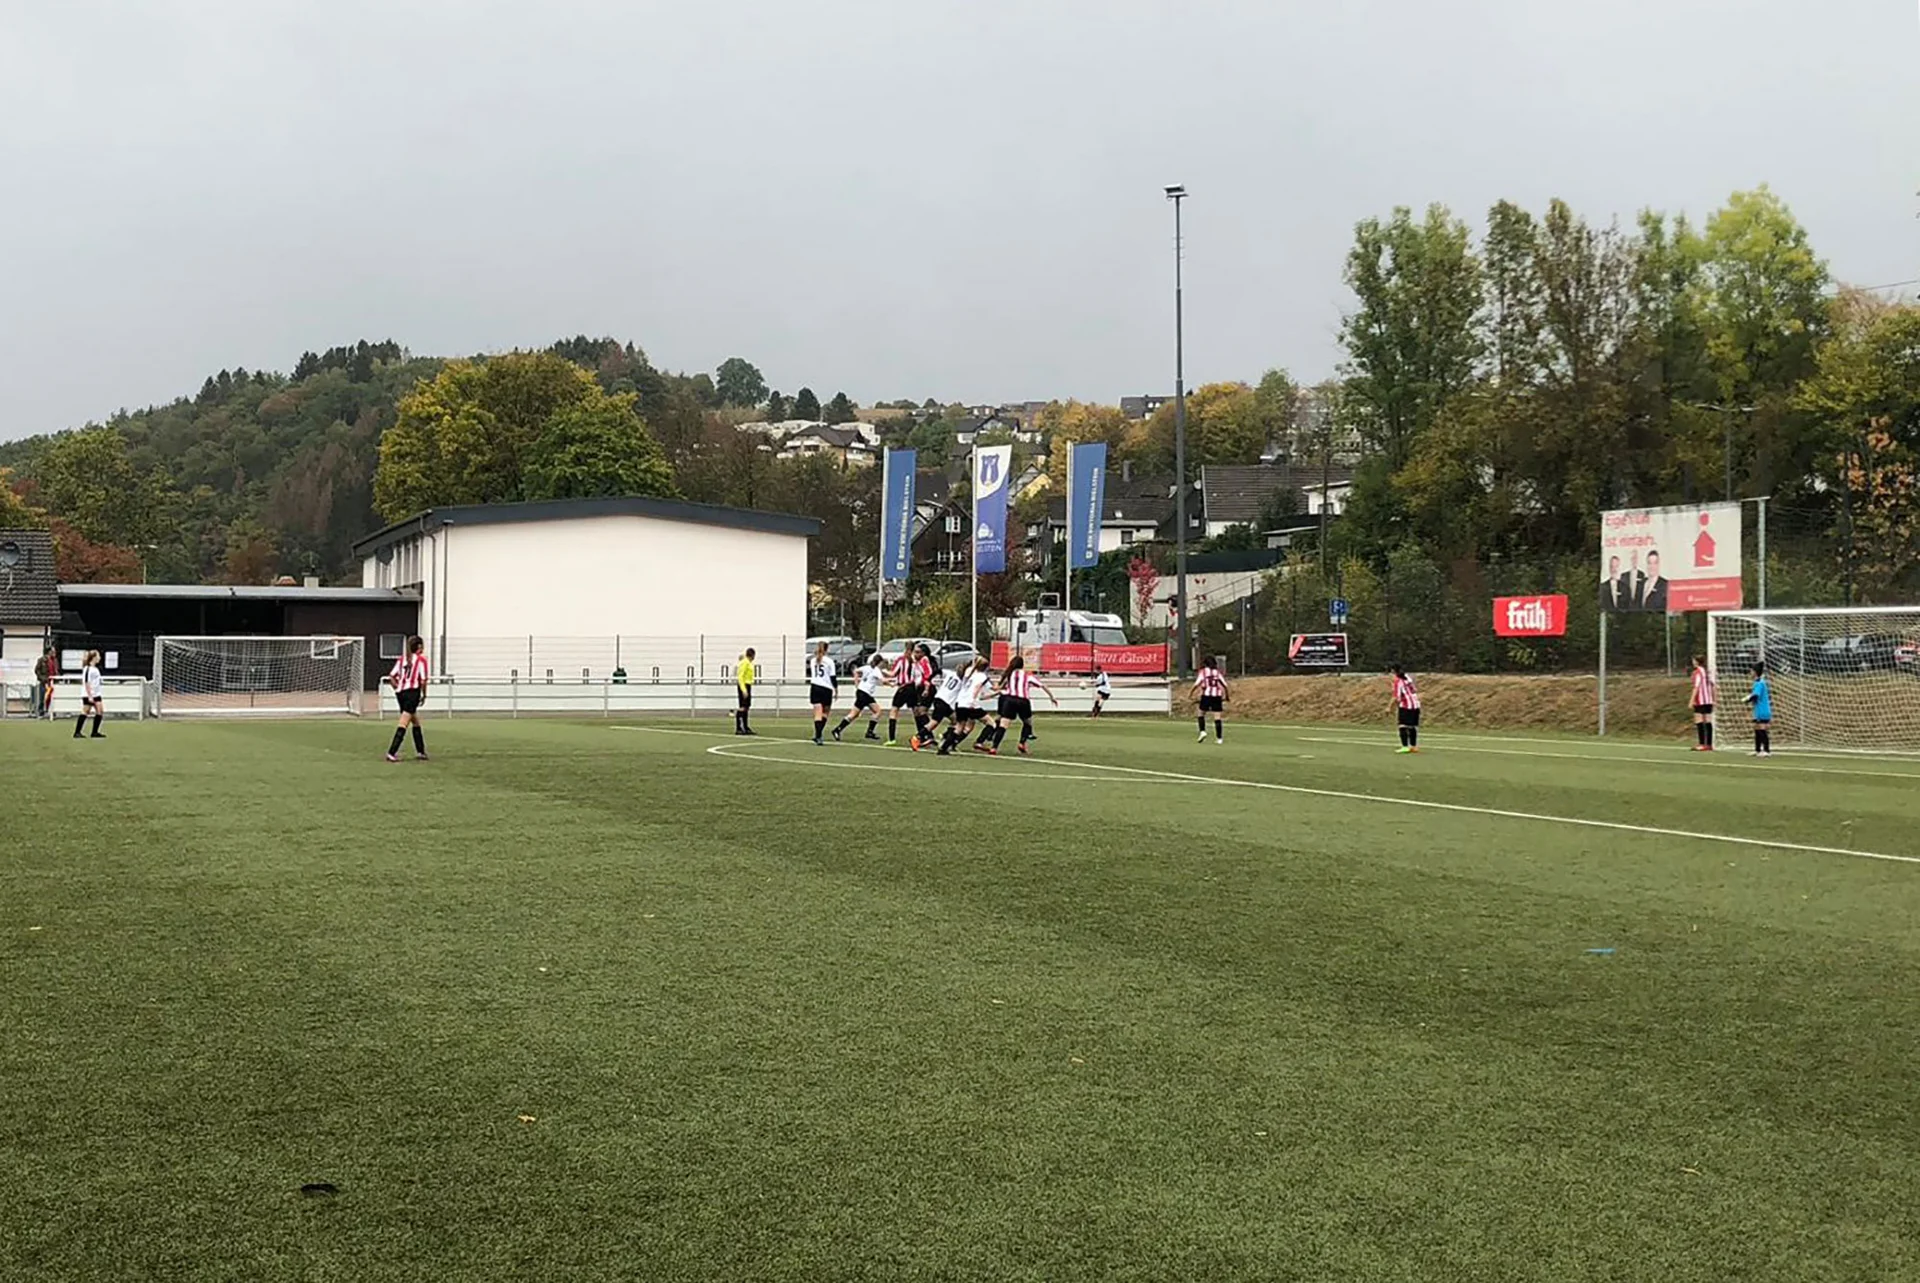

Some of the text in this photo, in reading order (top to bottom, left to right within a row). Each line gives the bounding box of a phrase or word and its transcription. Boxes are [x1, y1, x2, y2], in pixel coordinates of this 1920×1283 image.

[1506, 599, 1546, 632] früh
[814, 664, 825, 678] 15
[945, 676, 959, 691] 10
